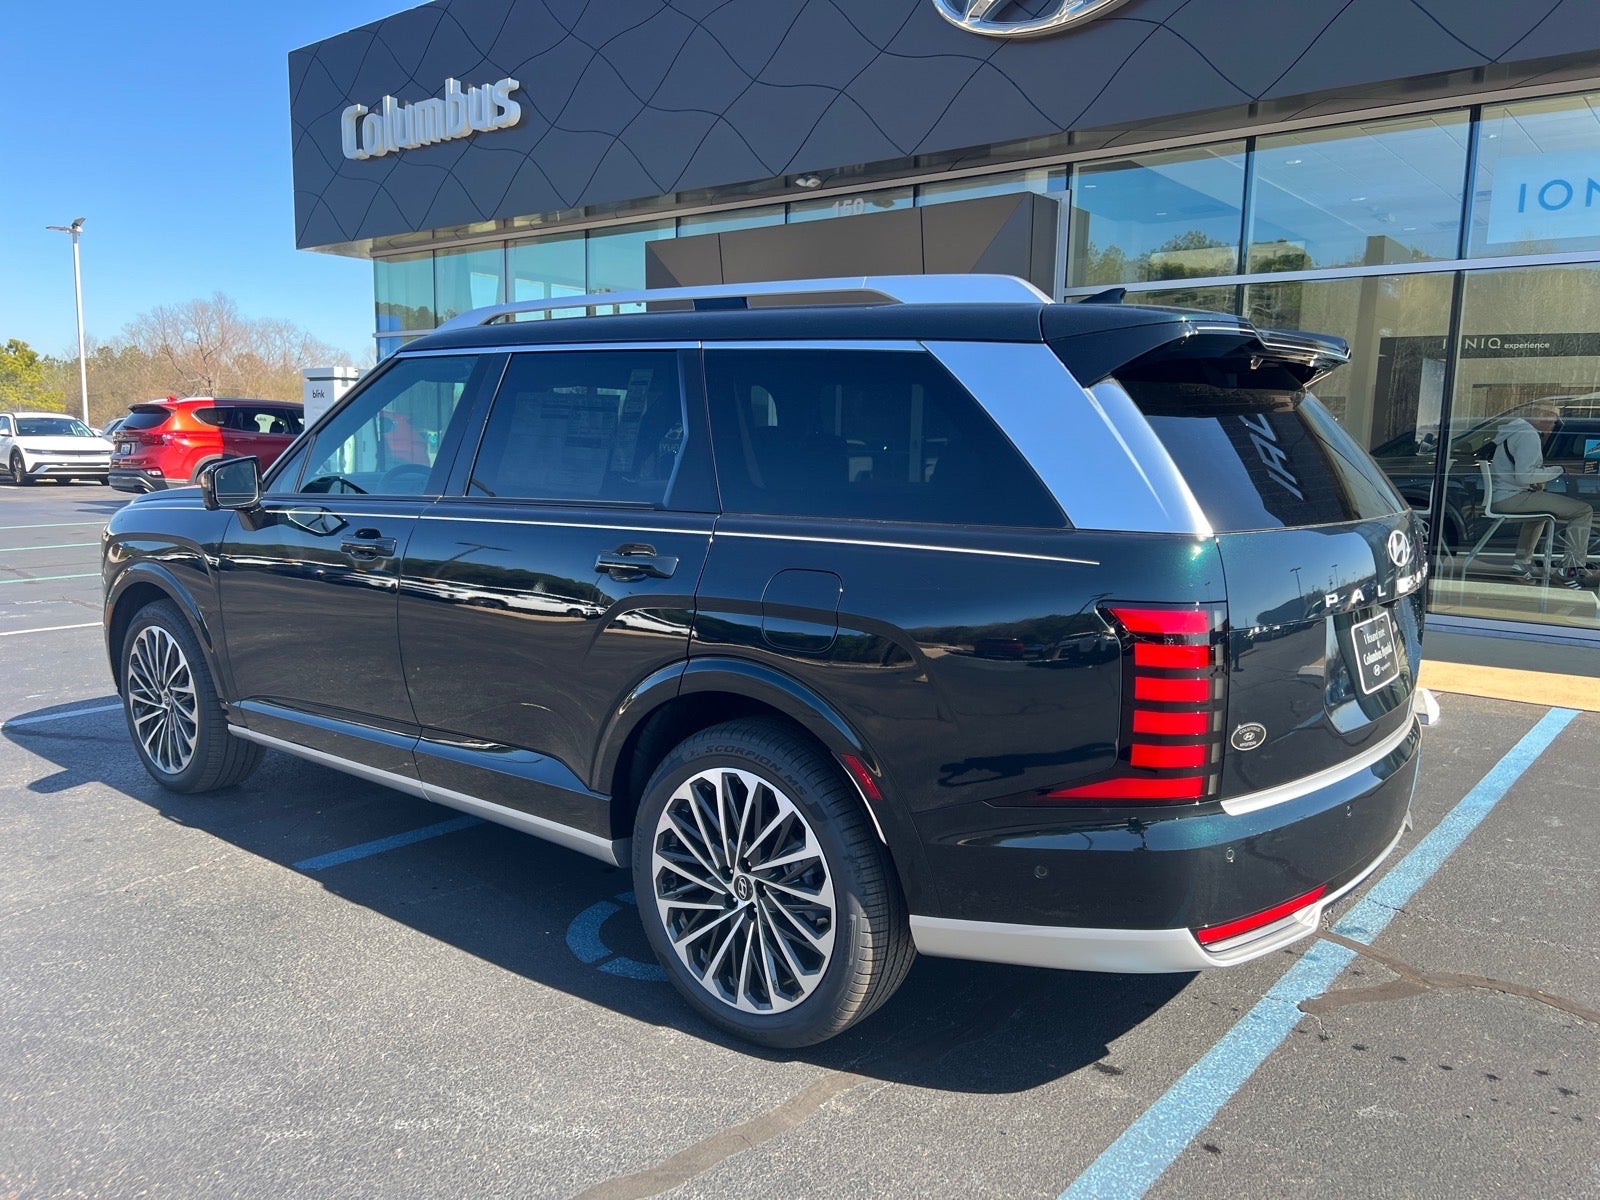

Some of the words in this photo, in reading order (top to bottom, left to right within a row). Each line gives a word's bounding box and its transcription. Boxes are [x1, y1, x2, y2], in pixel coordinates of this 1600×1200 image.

[341, 77, 521, 160] Columbus
[832, 197, 864, 217] 150
[1443, 337, 1501, 350] INIQ
[1504, 341, 1550, 350] experience
[312, 389, 325, 399] blink
[705, 744, 782, 772] SCORPION
